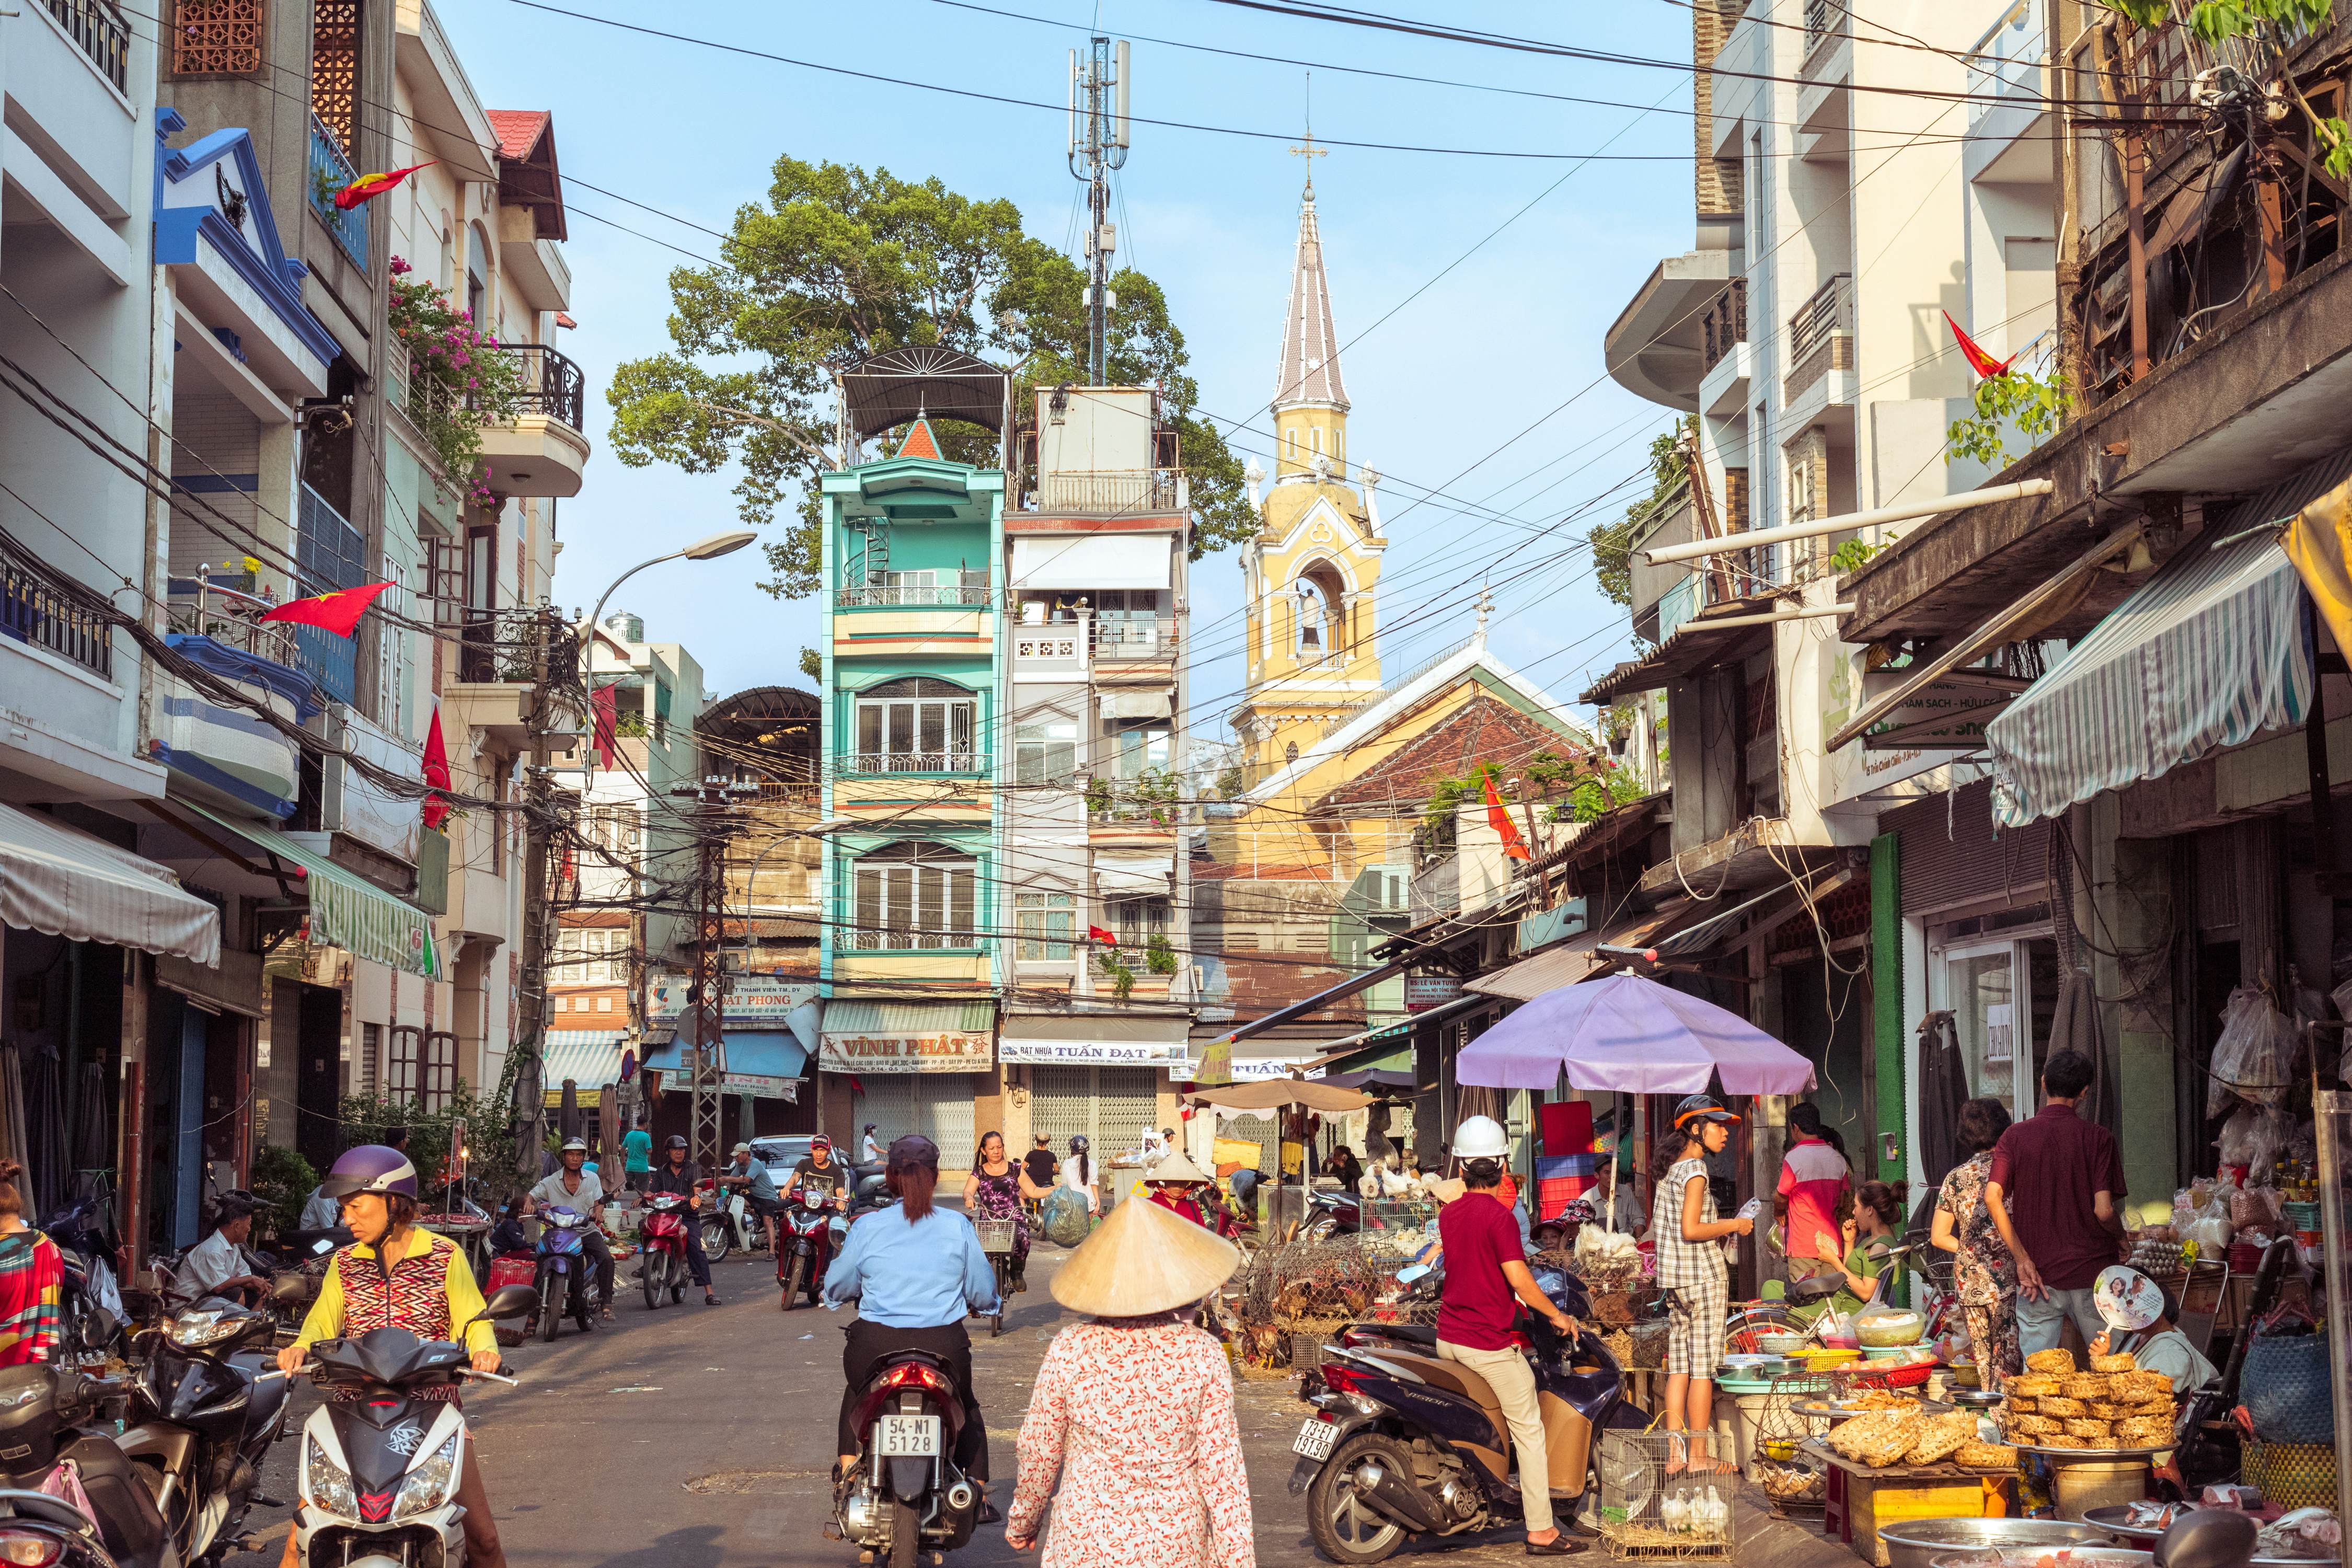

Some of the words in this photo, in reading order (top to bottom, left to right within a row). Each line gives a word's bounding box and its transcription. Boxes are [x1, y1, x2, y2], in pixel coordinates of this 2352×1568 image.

[747, 995, 791, 1005] PHONG
[842, 1036, 901, 1057] VĨNH
[905, 1034, 967, 1056] PHÁT
[1020, 1047, 1033, 1056] BẠT
[1035, 1046, 1052, 1056] NHỰA
[1055, 1044, 1103, 1057] TUẤN
[1109, 1048, 1146, 1060] ĐẠT
[1232, 1061, 1285, 1074] TUẤN
[187, 1357, 210, 1366] HONDA
[890, 1419, 929, 1435] 54-N1
[1306, 1420, 1333, 1441] 73-E1
[889, 1436, 931, 1452] 5128
[1295, 1436, 1329, 1458] 191.90
